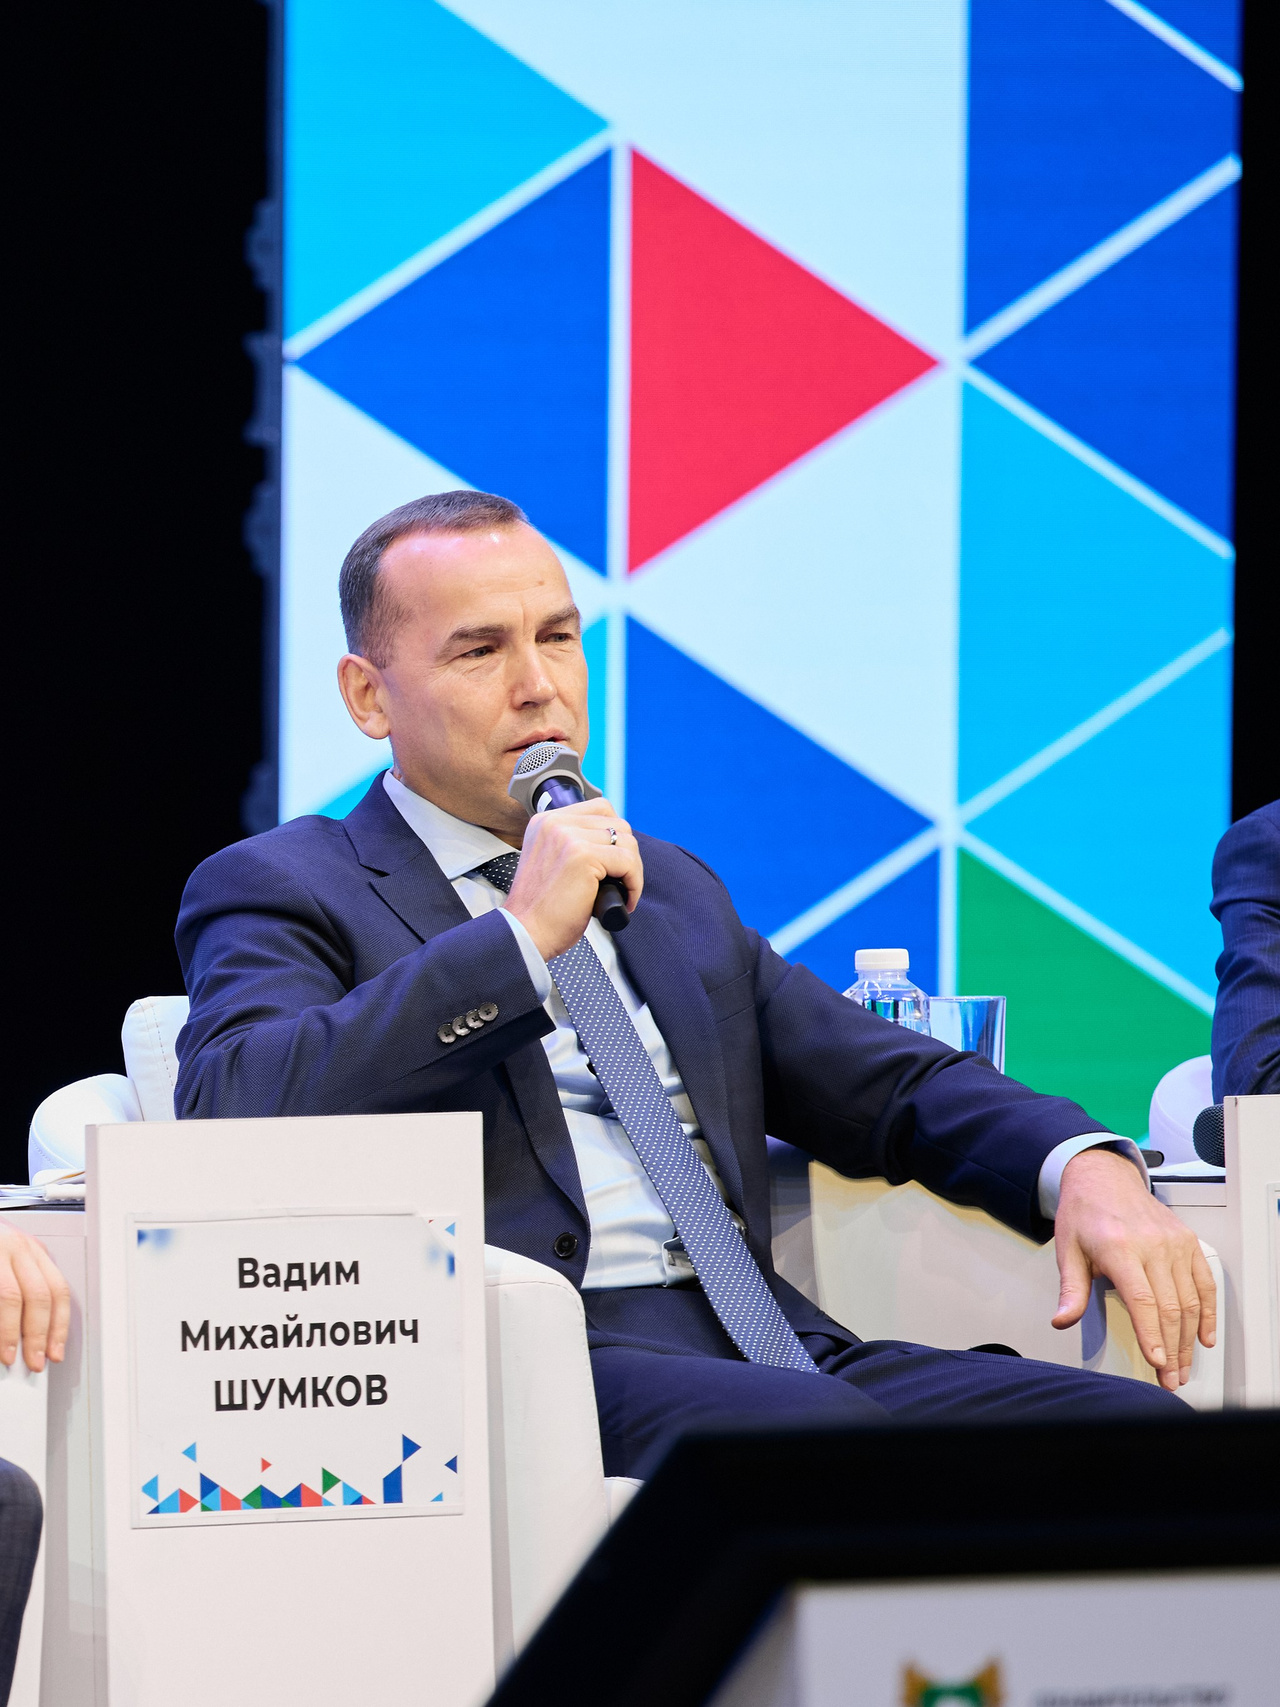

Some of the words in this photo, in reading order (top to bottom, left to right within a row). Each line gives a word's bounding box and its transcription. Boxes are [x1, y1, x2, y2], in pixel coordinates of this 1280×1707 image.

[237, 1257, 360, 1292] Вадим
[180, 1314, 419, 1352] Михайлович
[214, 1374, 389, 1412] ШУМКОВ
